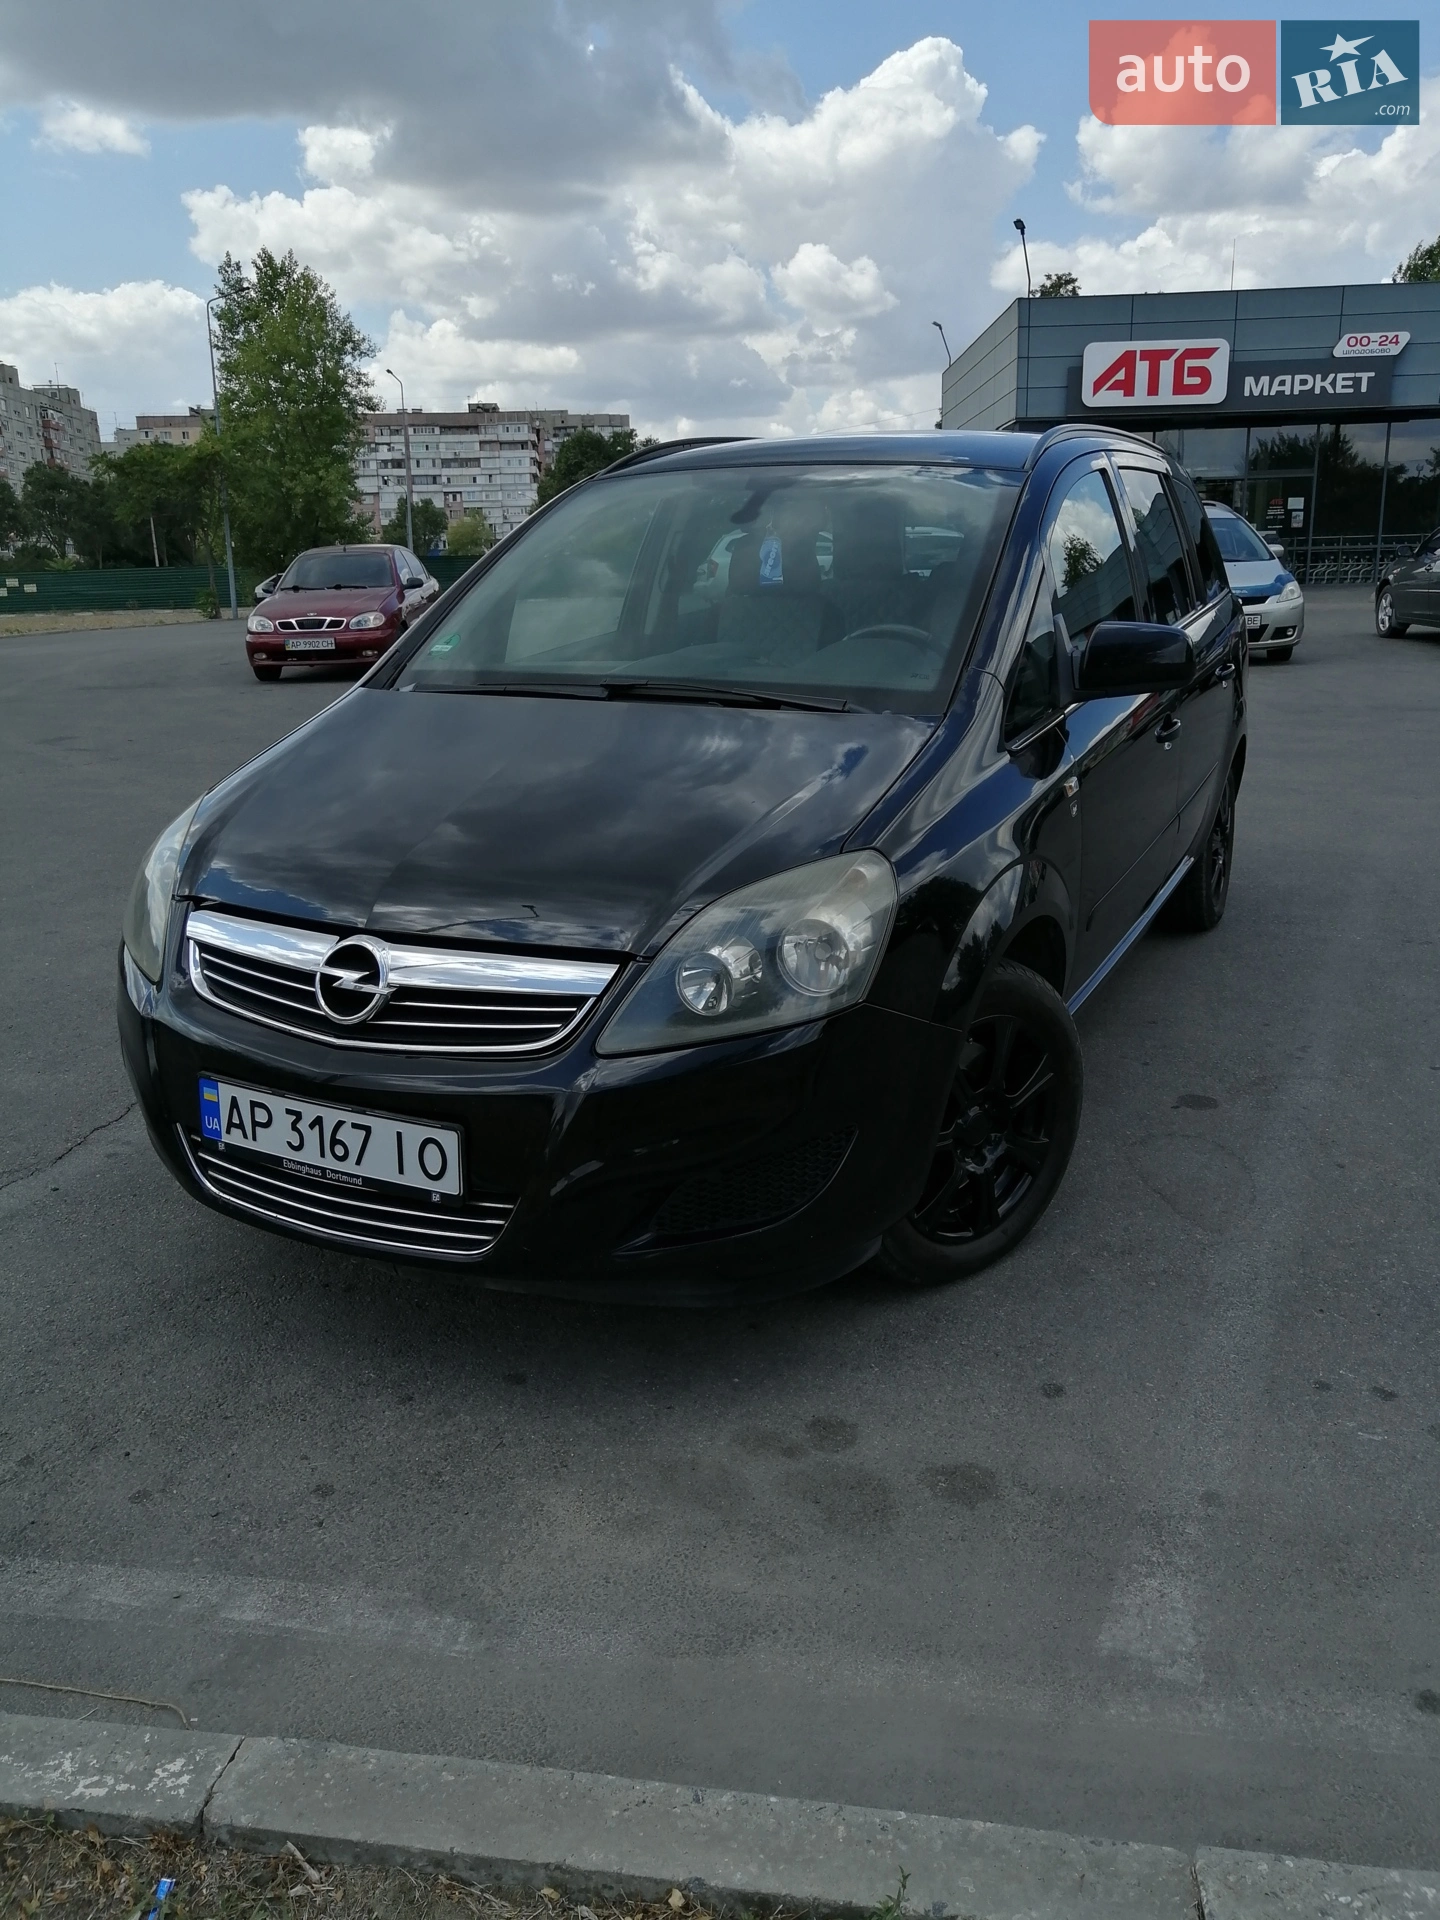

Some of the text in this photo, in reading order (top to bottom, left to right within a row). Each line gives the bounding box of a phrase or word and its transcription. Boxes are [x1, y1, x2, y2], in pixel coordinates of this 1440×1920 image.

[1346, 334, 1400, 347] 00-24
[1092, 347, 1376, 398] АТБ МАРКЕТ
[302, 640, 320, 649] 9902
[205, 1115, 221, 1132] UA
[225, 1095, 273, 1142] AP
[285, 1107, 372, 1166] 3167
[282, 1158, 363, 1185] Ebbinghaus Dortmund
